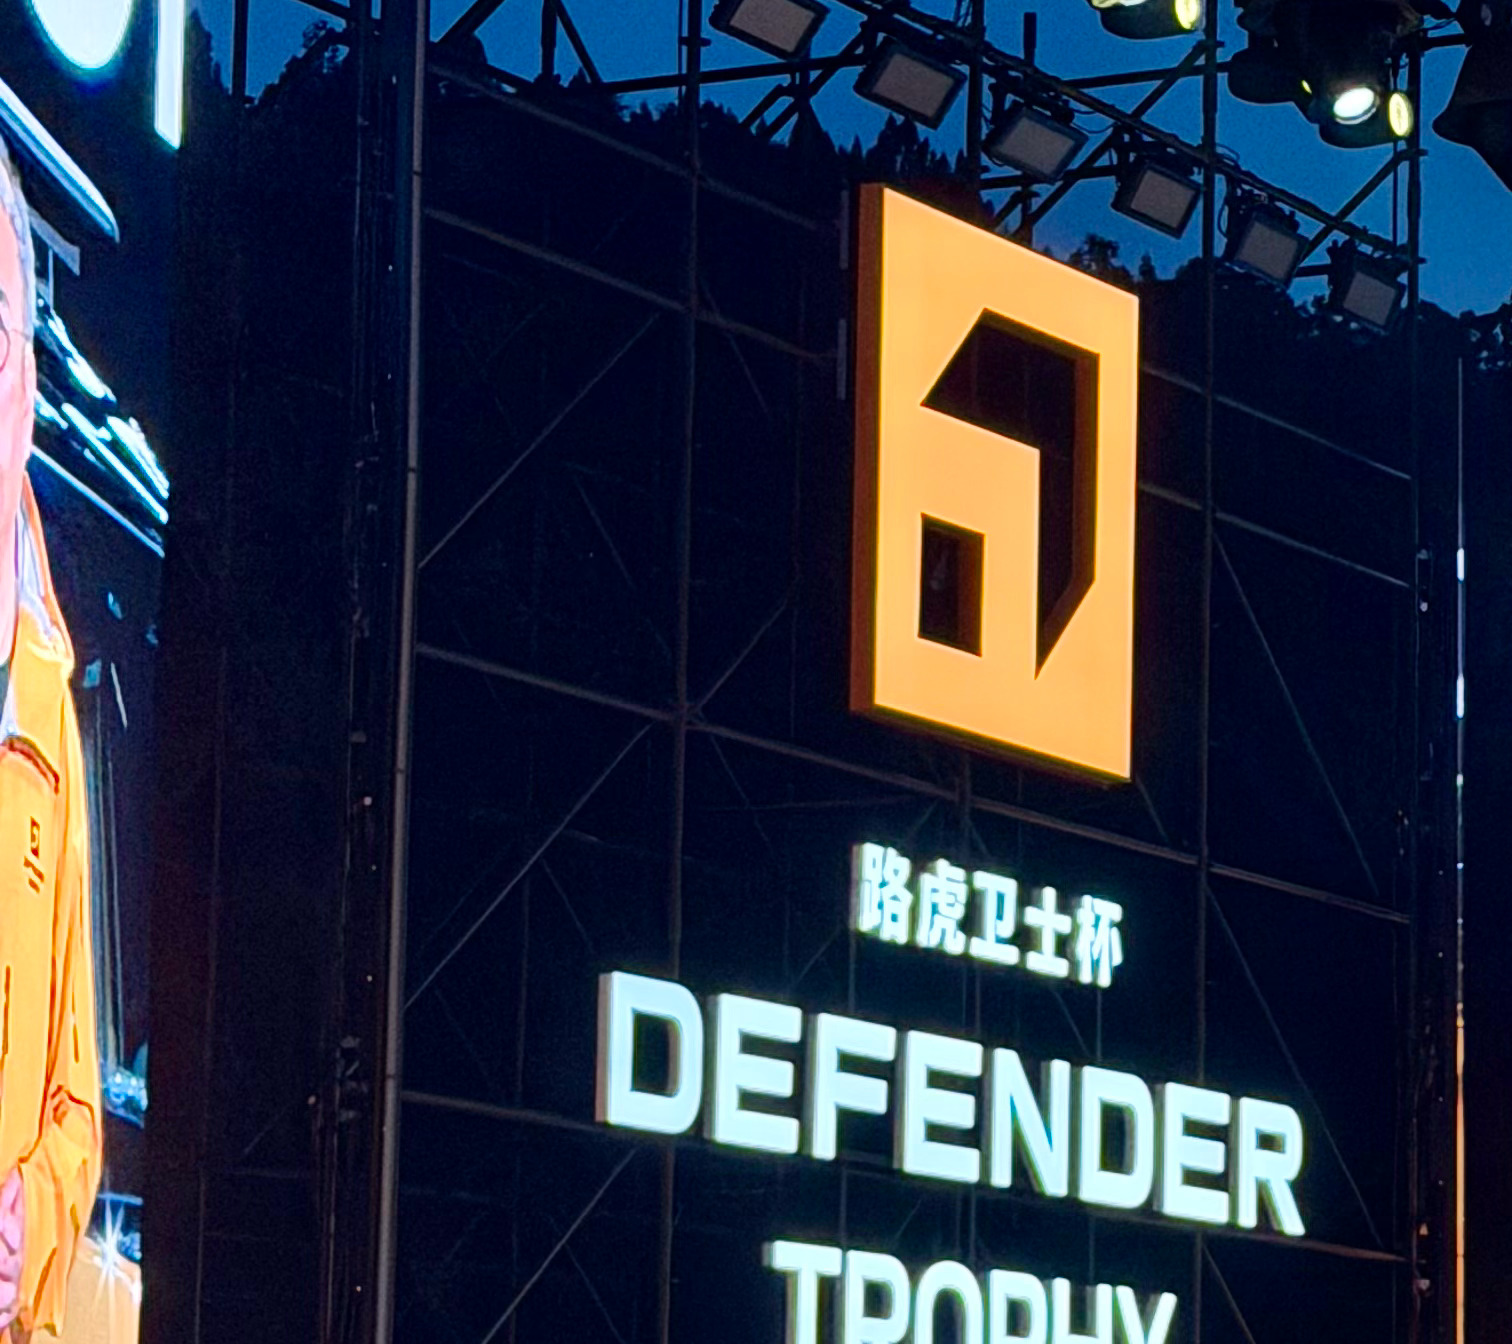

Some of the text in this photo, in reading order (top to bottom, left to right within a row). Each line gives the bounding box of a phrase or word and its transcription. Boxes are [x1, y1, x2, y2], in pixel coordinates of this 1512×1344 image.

[852, 841, 1124, 988] 路虎卫士杯
[598, 970, 1306, 1237] DEFENDER
